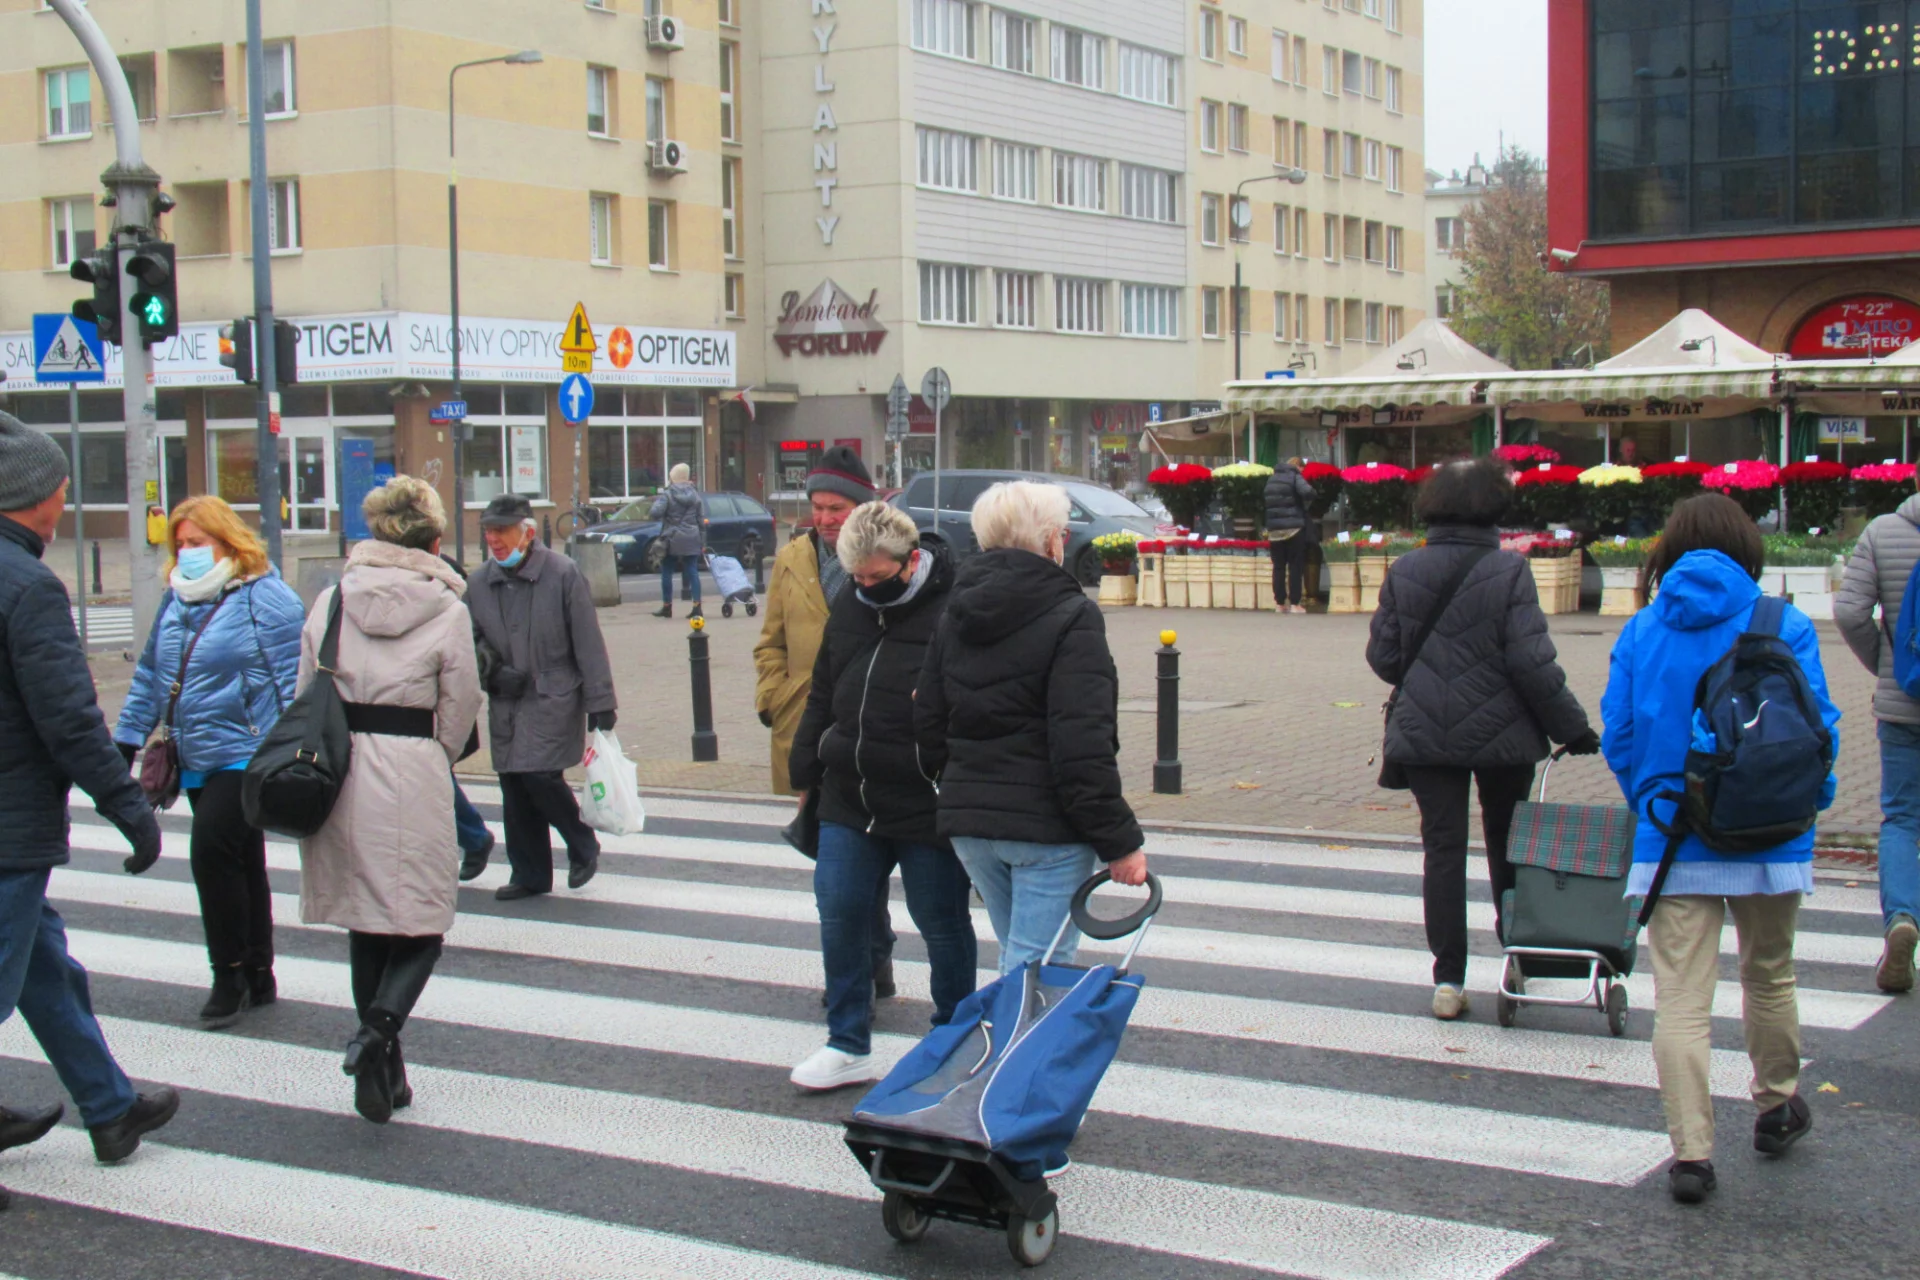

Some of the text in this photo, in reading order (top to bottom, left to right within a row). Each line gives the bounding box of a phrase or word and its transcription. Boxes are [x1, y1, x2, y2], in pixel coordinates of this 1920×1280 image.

[778, 288, 879, 323] Lombard
[1851, 319, 1913, 336] MIRO
[409, 323, 495, 355] SALONY
[638, 334, 730, 366] OPTIGEM
[778, 332, 884, 357] FORUM
[441, 402, 465, 418] TAXI
[1826, 421, 1858, 433] VISA
